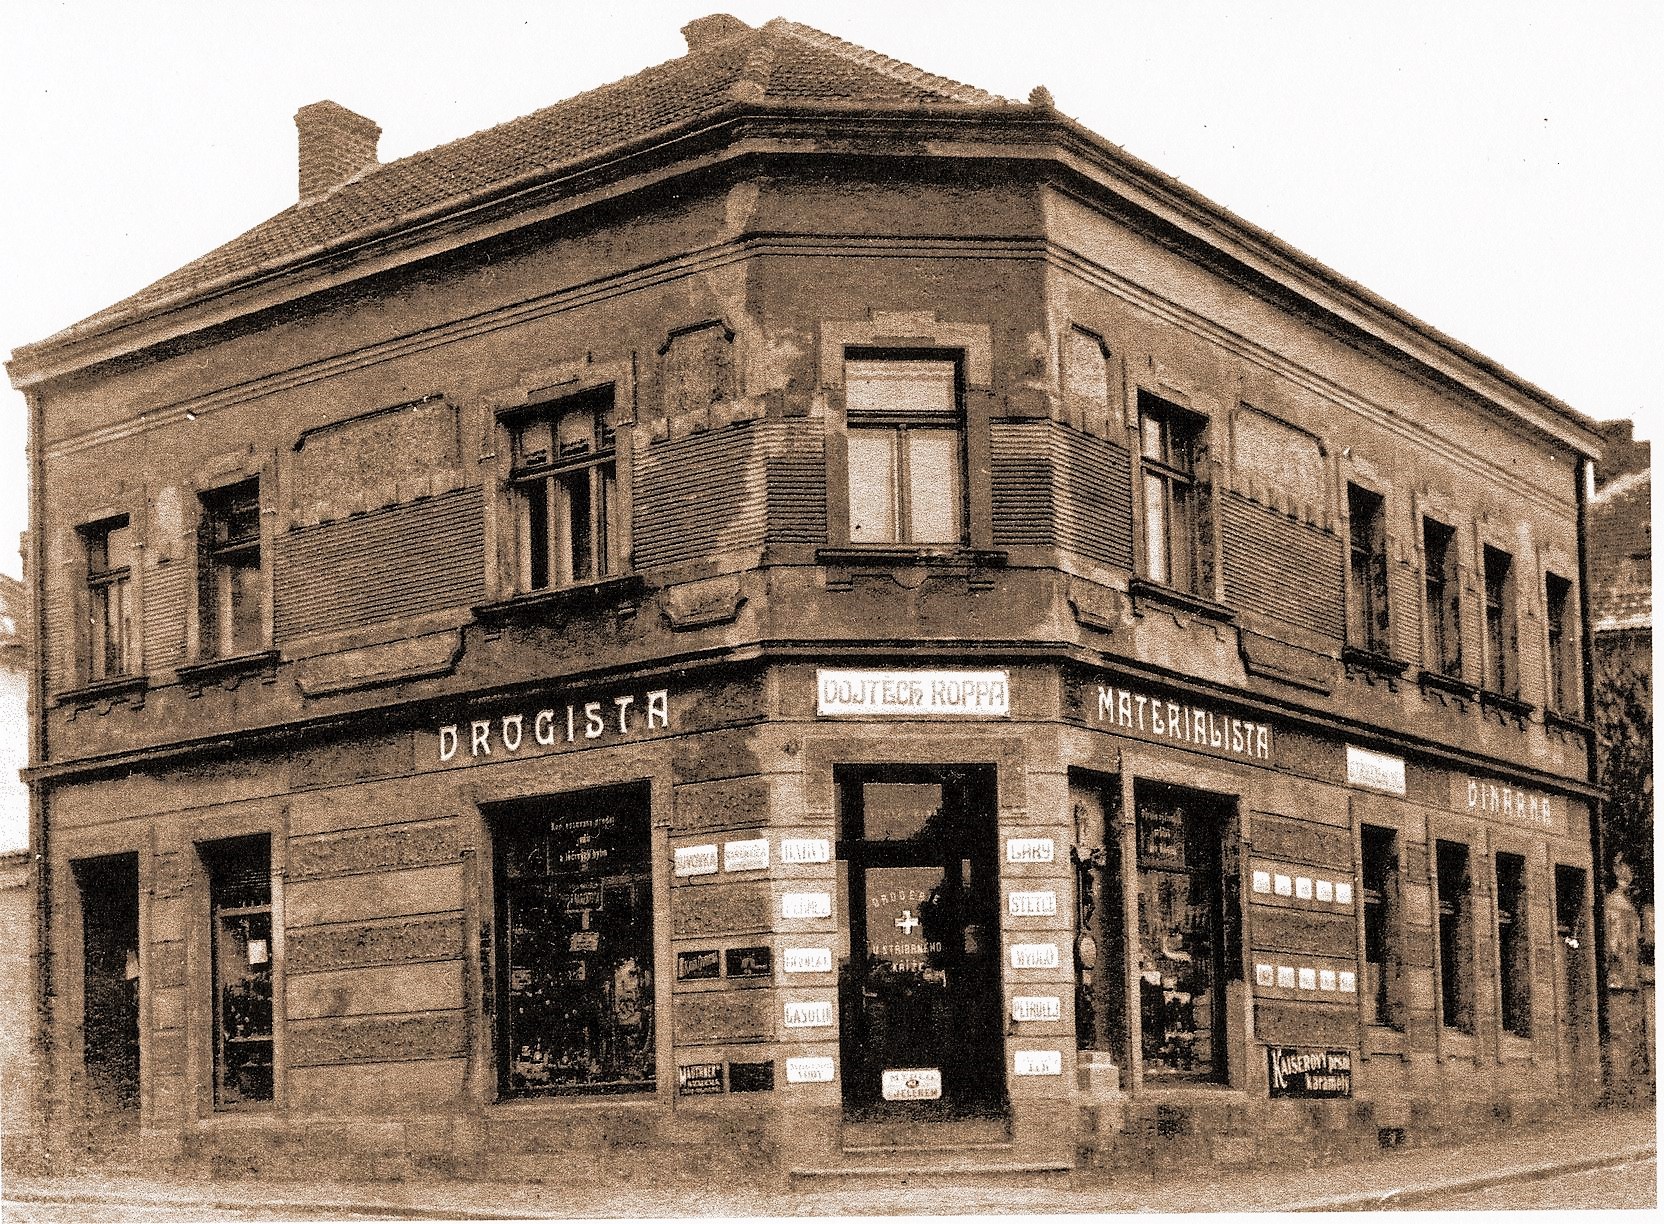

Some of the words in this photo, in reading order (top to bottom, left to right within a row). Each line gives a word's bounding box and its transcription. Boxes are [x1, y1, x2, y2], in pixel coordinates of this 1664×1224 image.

[439, 688, 669, 761] DROGISTA
[1098, 686, 1269, 759] MATERIALISTA
[871, 890, 941, 908] DROGERIE
